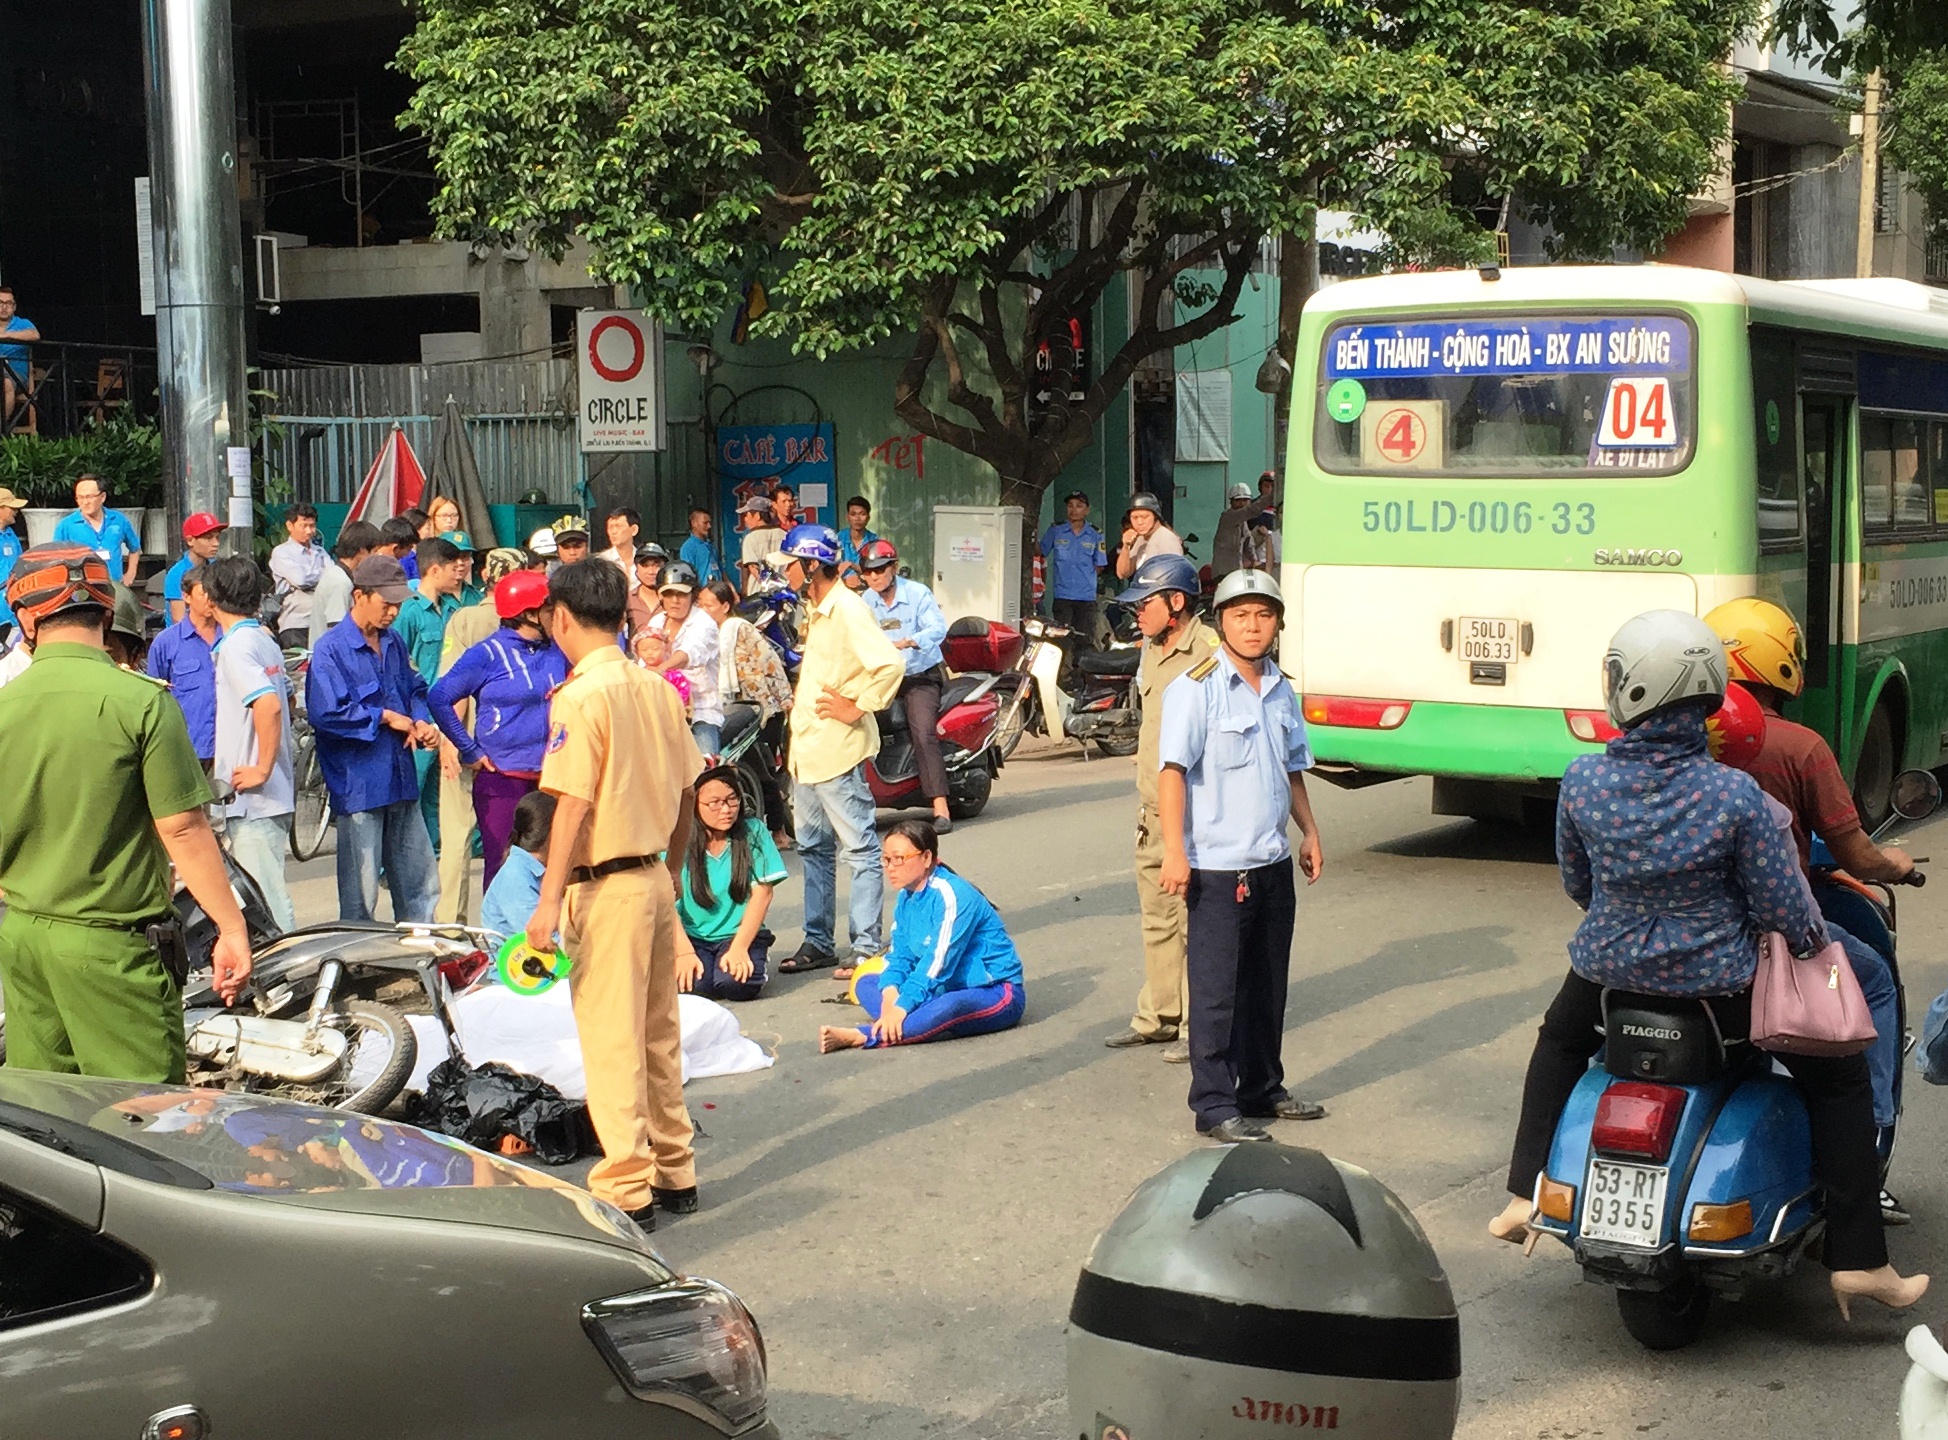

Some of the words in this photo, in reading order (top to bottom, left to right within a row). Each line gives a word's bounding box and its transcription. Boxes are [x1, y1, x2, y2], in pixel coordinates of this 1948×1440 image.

[1336, 328, 1368, 370] BẾN
[1374, 330, 1430, 369] THÀNH
[1443, 328, 1490, 374] CỘNG
[1495, 326, 1531, 366] HOÀ
[1546, 333, 1572, 365] BX
[1575, 332, 1602, 365] AN
[1608, 327, 1671, 365] SƯƠNG
[588, 397, 649, 425] CIRCLE
[1612, 383, 1667, 440] 04
[785, 436, 829, 464] BAR
[1383, 414, 1416, 458] 4
[1594, 548, 1683, 567] SAMCO
[1471, 621, 1506, 639] 50LD
[1465, 641, 1512, 660] 006.33
[1622, 1024, 1682, 1040] PIAGGIO
[1590, 1197, 1655, 1231] 9355
